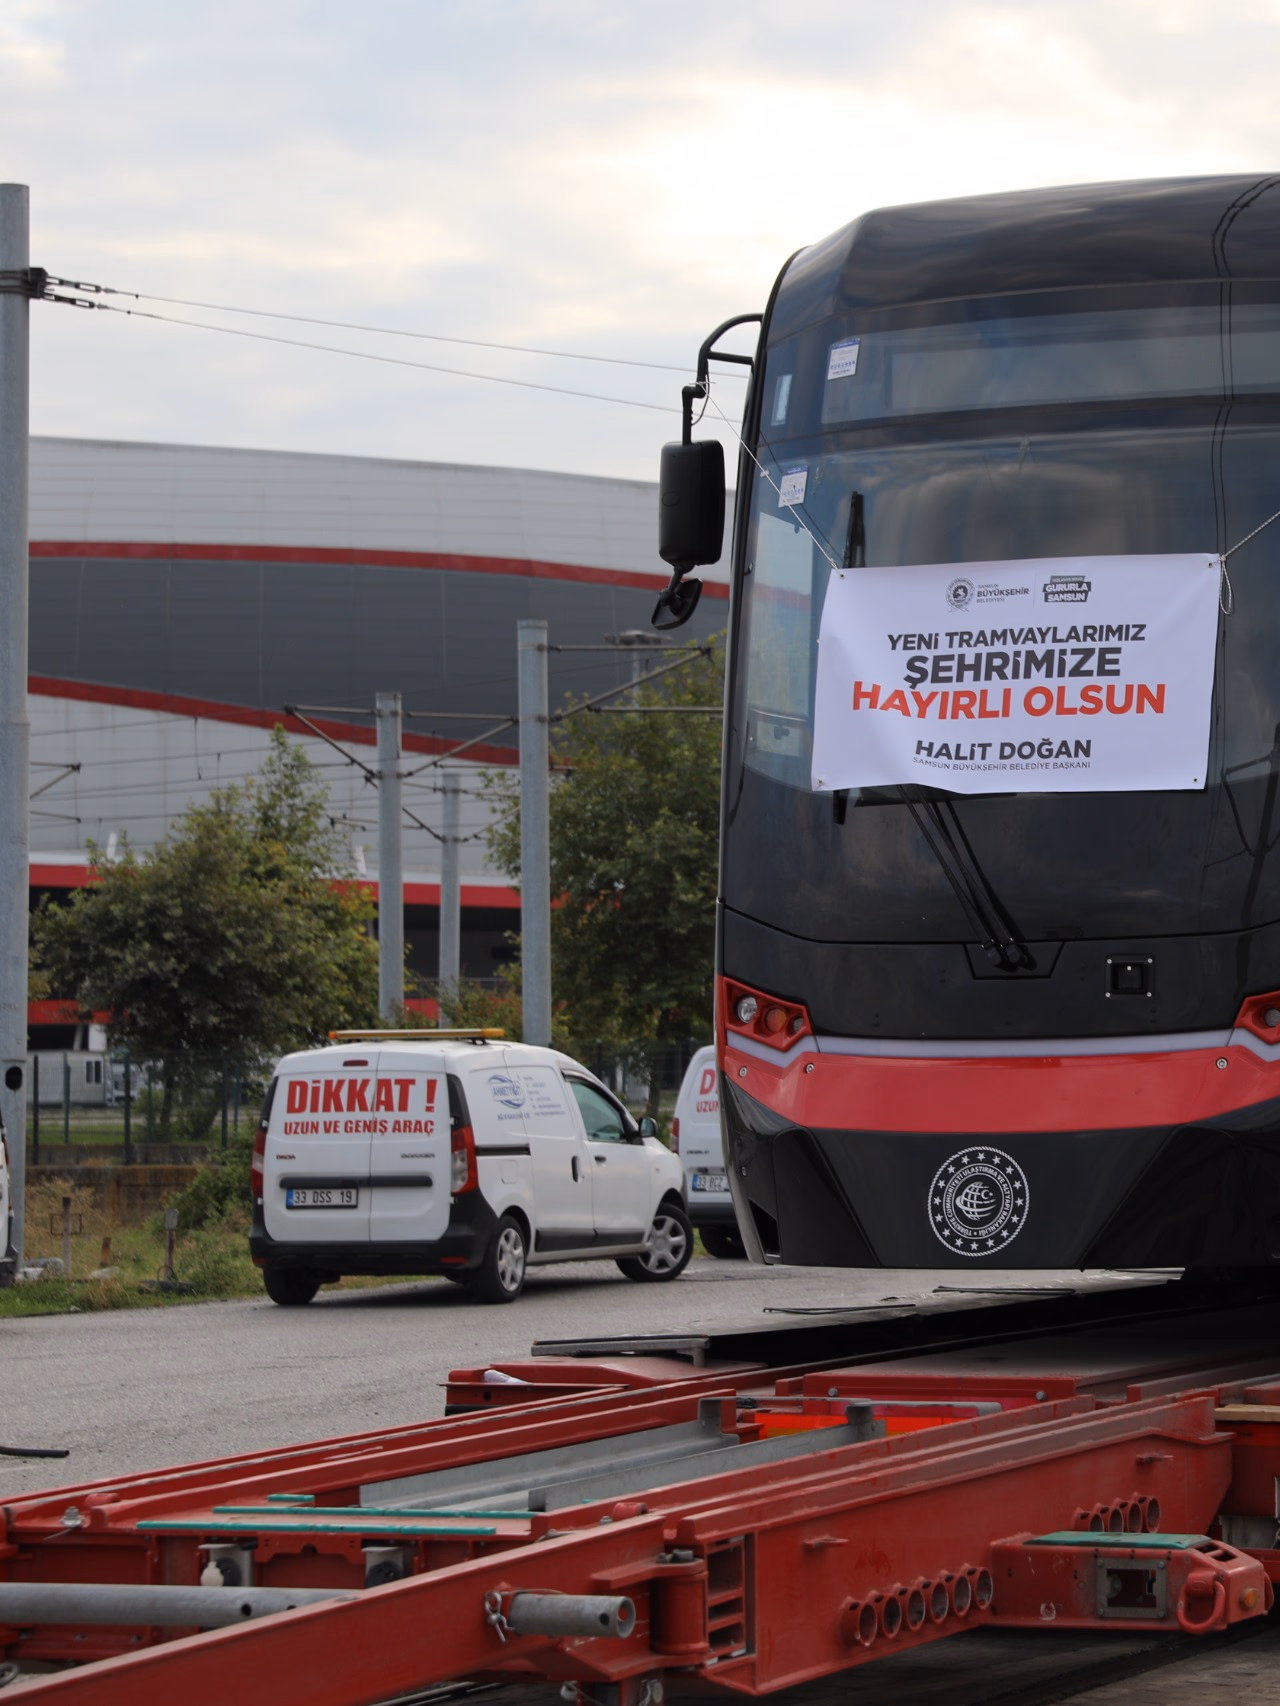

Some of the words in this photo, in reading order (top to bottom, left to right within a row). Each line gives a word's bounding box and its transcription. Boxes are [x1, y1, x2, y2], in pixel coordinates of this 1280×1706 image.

[976, 587, 1030, 597] BÜYÜKŞEHİR
[1045, 582, 1089, 592] GURURLA
[1047, 592, 1086, 602] SAMSUN
[887, 632, 939, 651] YENİ
[945, 624, 1147, 649] TRAMVAYLARIMIZ
[903, 647, 1122, 690] ŞEHRİMİZE
[852, 680, 1012, 720] HAYIRLI
[1023, 684, 1166, 717] OLSUN
[915, 740, 993, 761] HALİT
[999, 738, 1092, 761] DOĞAN
[912, 756, 950, 770] SAMSUN
[952, 761, 1007, 772] BÜYÜKŞEHİR
[1009, 761, 1051, 771] BELEDİYE
[1052, 760, 1091, 771] BAŞKANI
[284, 1120, 320, 1135] UZUN
[323, 1120, 341, 1134] VE
[344, 1117, 388, 1136] GENİŞ
[392, 1119, 435, 1136] ARAÇ
[962, 1166, 998, 1177] ULAŞTIRMA
[997, 1174, 1006, 1183] VE
[294, 1190, 307, 1204] 33
[312, 1190, 332, 1203] DSS
[340, 1190, 352, 1203] 19
[946, 1172, 963, 1217] CUMHURİYETİ
[1002, 1183, 1011, 1211] ALTYAPI
[978, 1210, 1008, 1237] BAKANLIĞI
